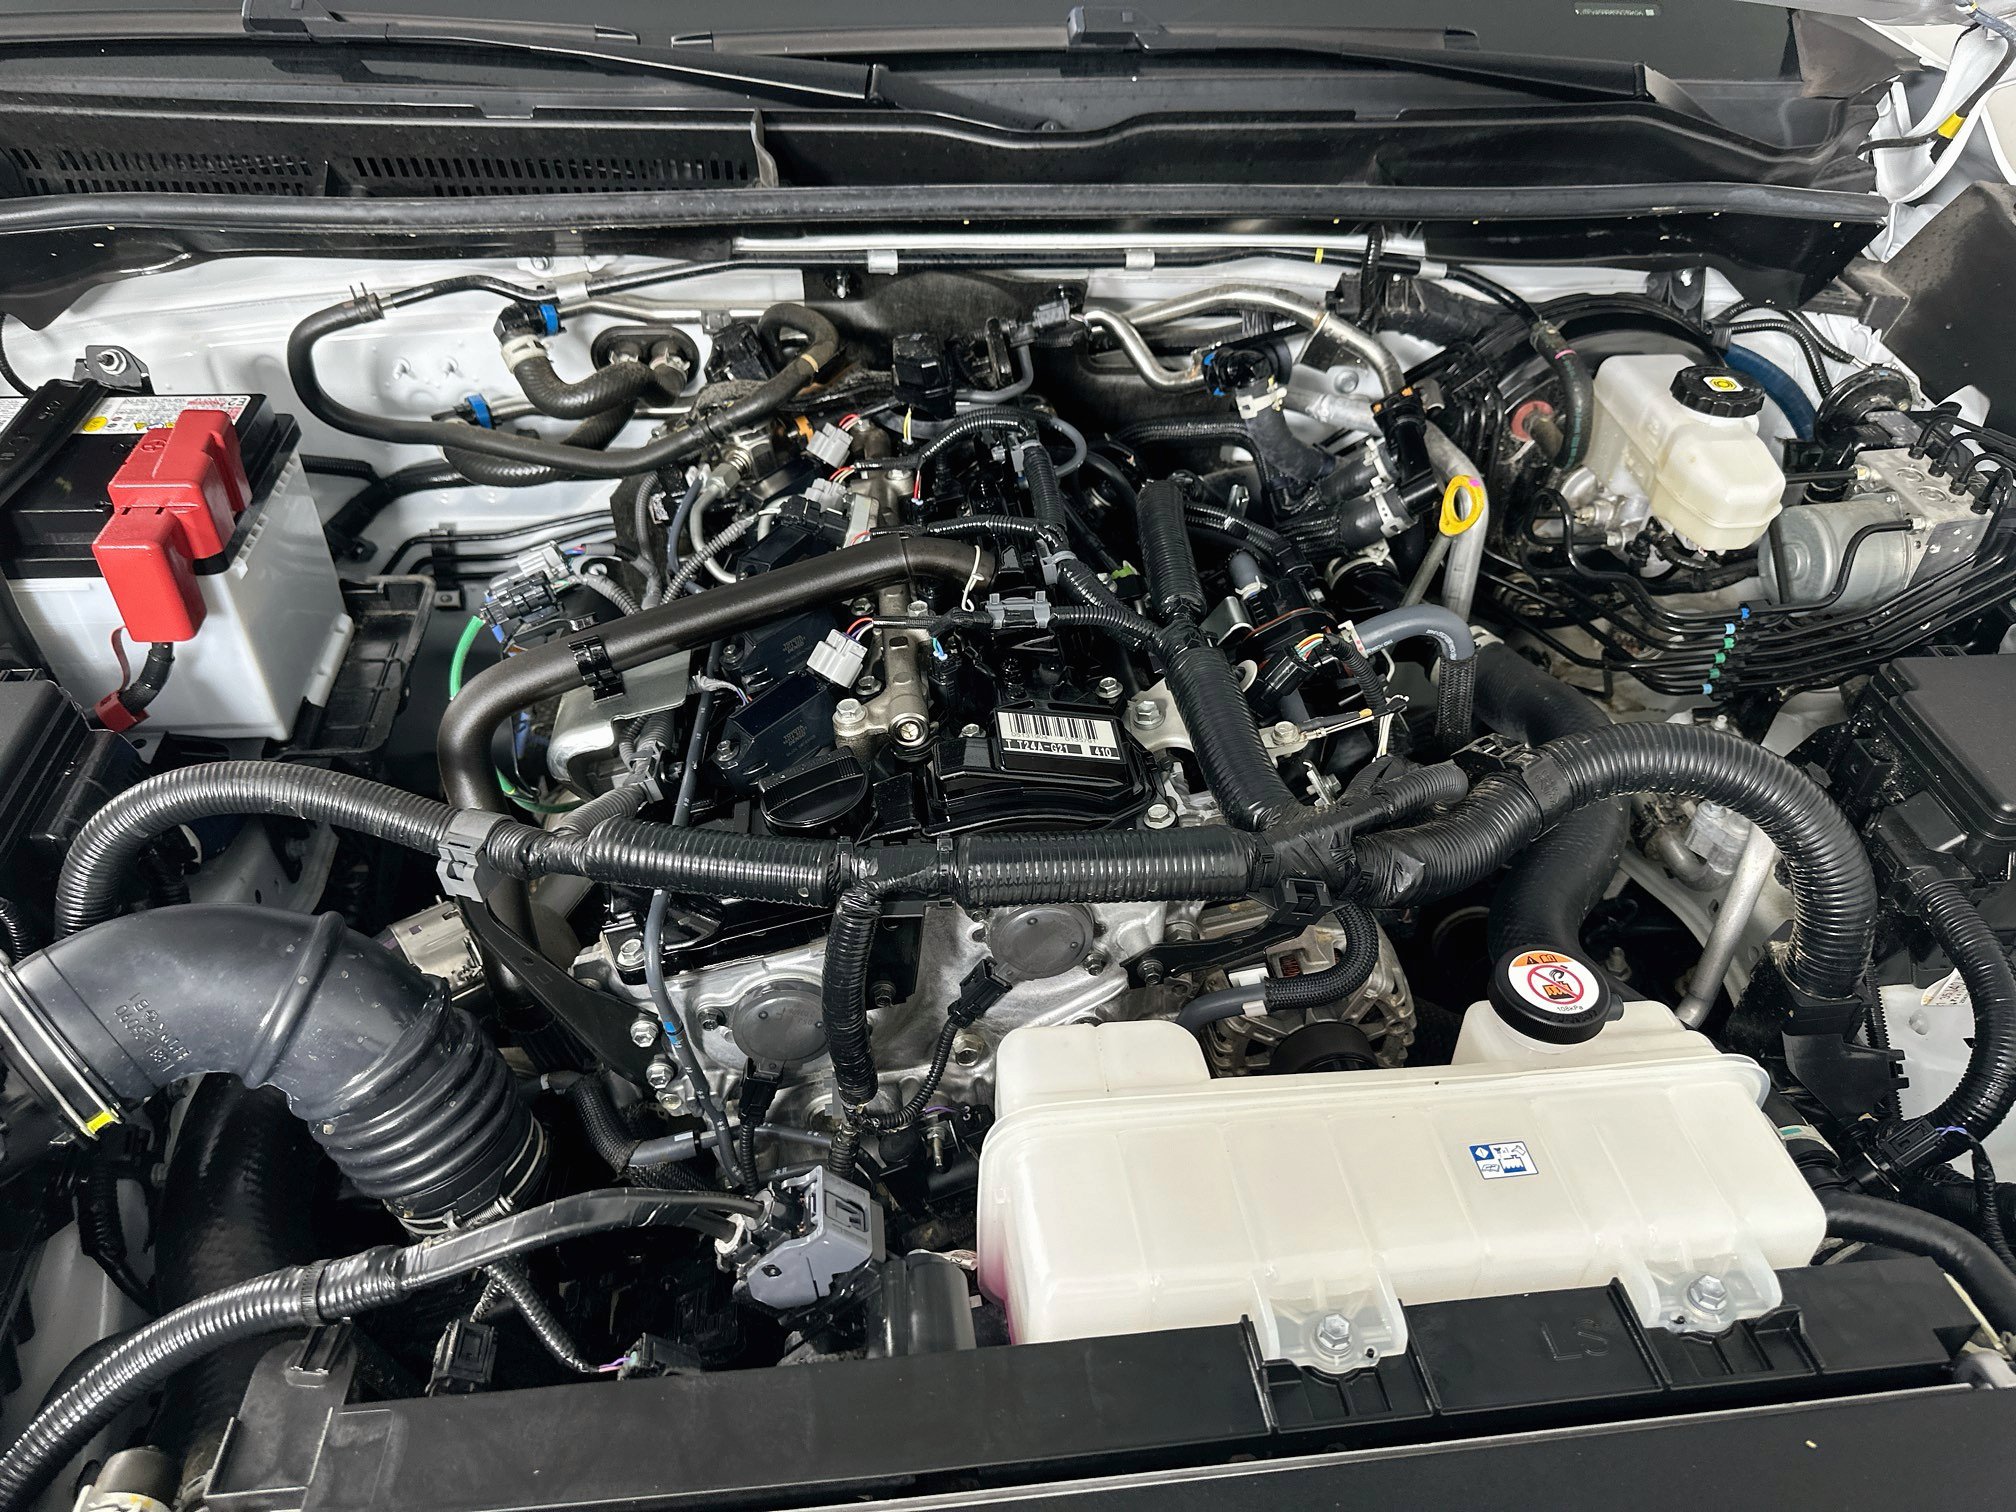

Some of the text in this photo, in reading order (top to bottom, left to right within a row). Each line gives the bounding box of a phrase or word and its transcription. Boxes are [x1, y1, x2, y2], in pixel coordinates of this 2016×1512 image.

[1005, 739, 1112, 757] T T24A-G21 410
